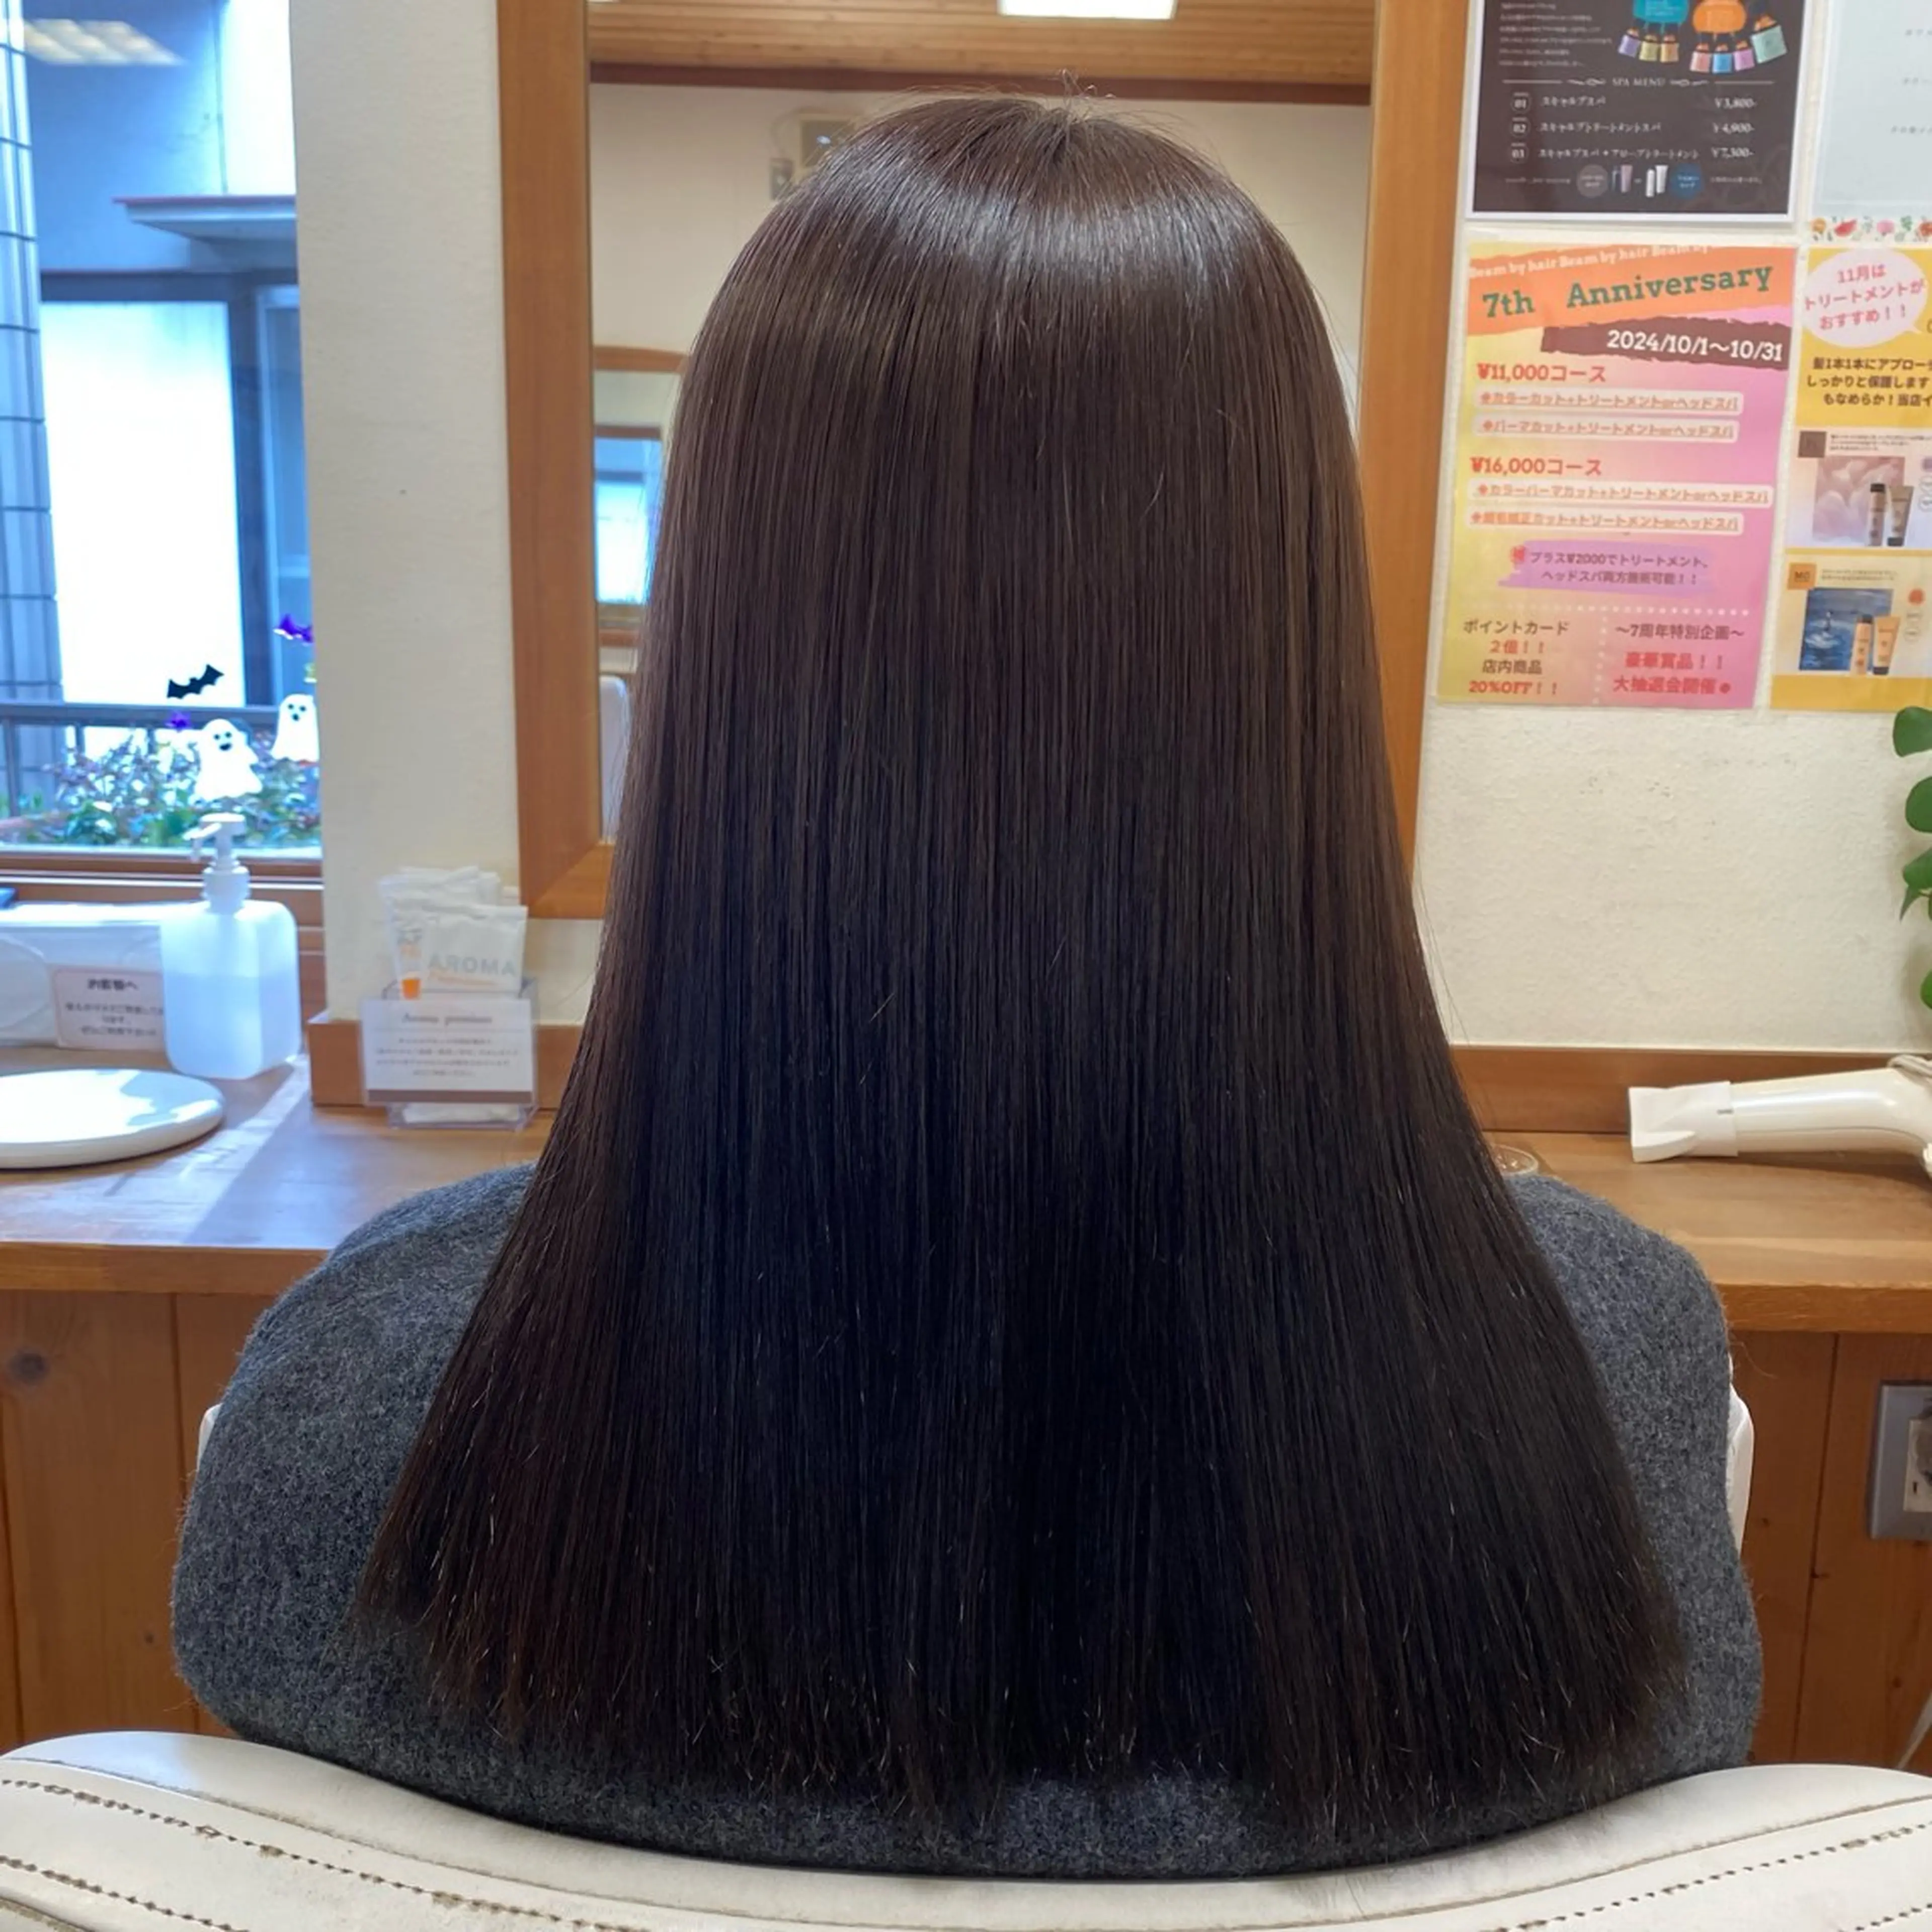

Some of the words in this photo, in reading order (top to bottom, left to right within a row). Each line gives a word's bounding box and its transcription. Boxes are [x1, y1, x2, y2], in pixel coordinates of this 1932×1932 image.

[1508, 260, 1525, 276] by
[1528, 258, 1556, 272] hair
[1559, 254, 1597, 267] Beam
[1599, 250, 1617, 265] by
[1619, 247, 1650, 261] hair
[1837, 264, 1886, 283] 11月は
[1482, 289, 1535, 317] 7th
[1566, 266, 1773, 308] Anniversary
[1805, 278, 1925, 310] トリートメントが
[1463, 618, 1570, 635] ポイントカード
[1482, 659, 1542, 674] 店内商品
